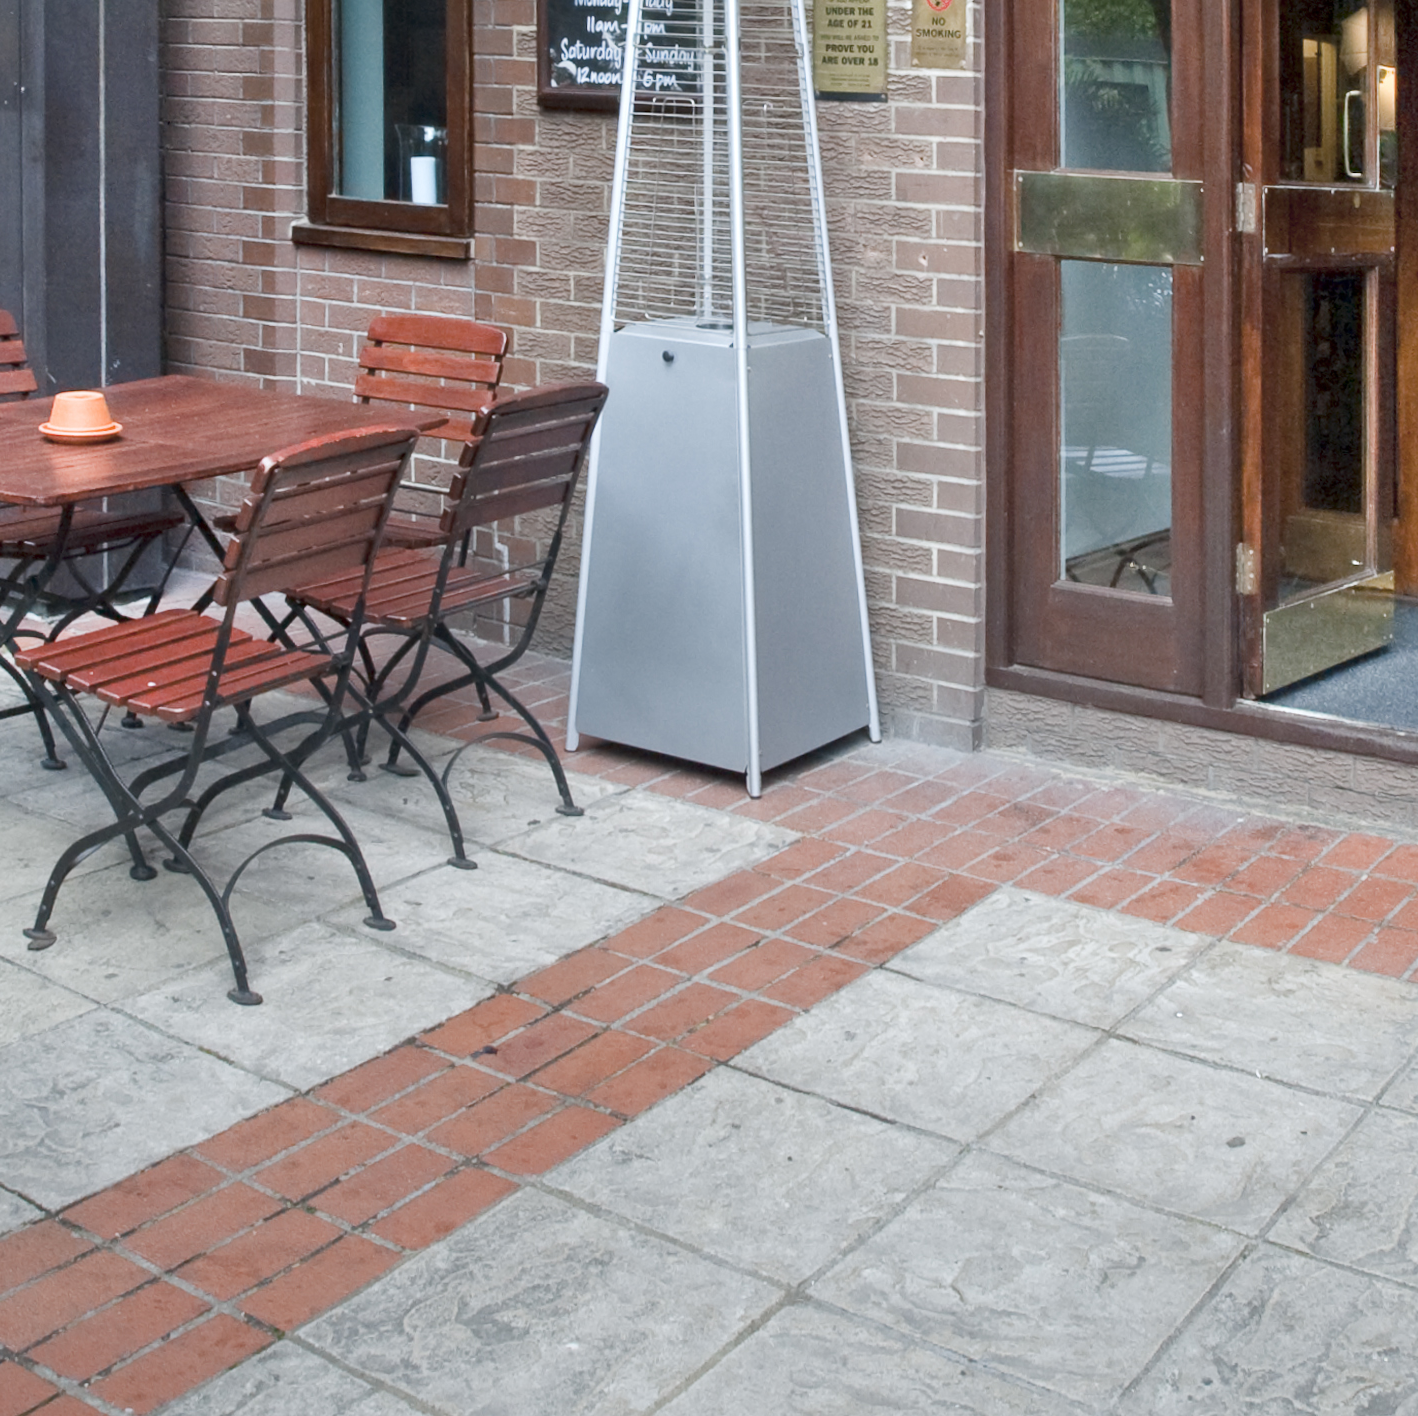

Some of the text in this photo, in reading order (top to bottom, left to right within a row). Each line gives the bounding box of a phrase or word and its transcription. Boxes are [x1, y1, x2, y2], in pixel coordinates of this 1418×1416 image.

[825, 6, 875, 16] UNDER THE
[827, 18, 873, 29] AGE OF 21
[931, 16, 947, 27] NO
[915, 28, 962, 39] SMOKING
[560, 37, 622, 70] Saturday
[645, 42, 695, 72] Sunday
[825, 44, 875, 54] PROVE YOU
[821, 55, 879, 67] ARE OVER 18
